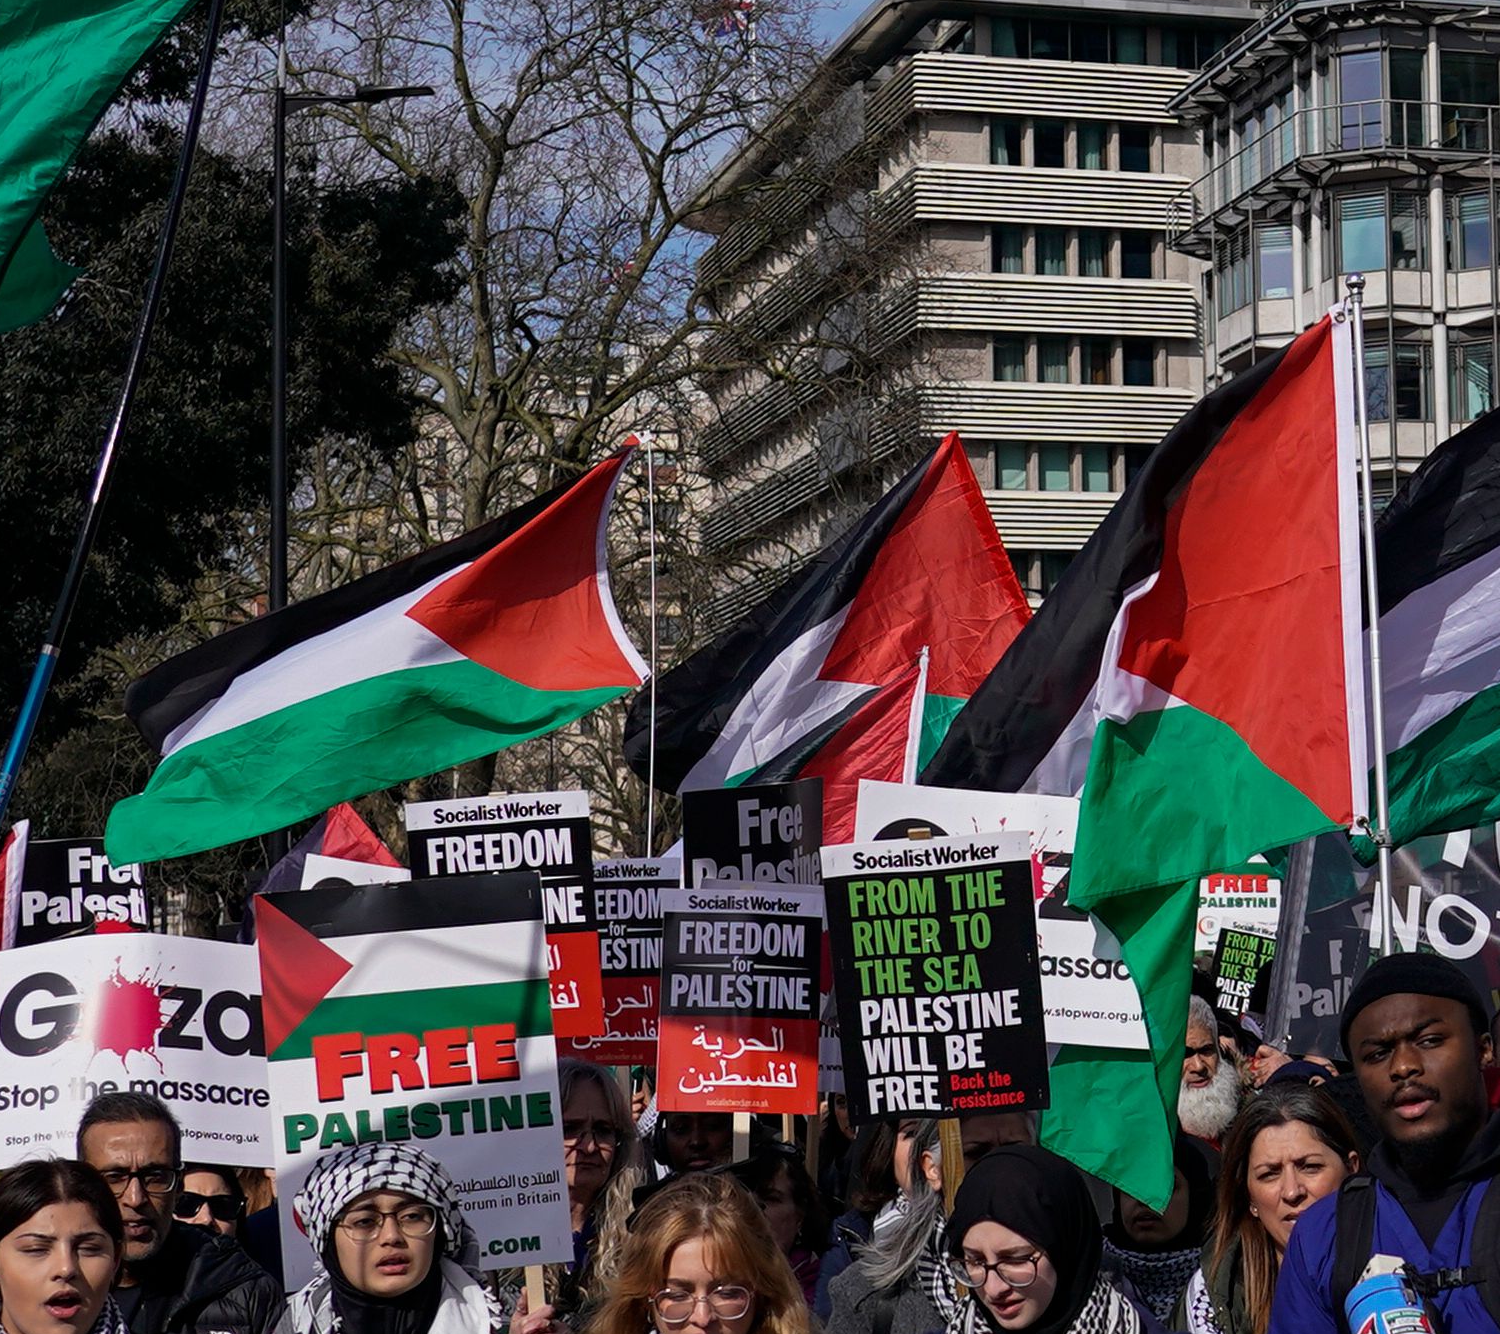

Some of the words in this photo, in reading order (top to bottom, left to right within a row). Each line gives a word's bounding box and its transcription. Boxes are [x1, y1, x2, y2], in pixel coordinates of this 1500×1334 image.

[737, 799, 803, 847] Free
[426, 827, 573, 876] FREEDOM
[848, 876, 937, 917] FROM
[945, 870, 1006, 909] THE
[1207, 872, 1269, 895] FREE
[21, 888, 147, 926] Palesti
[1199, 895, 1277, 909] PALESTINE
[609, 921, 627, 937] for
[678, 921, 805, 958] FREEDOM
[852, 916, 942, 957] RIVER
[950, 912, 992, 950] TO
[1225, 932, 1258, 951] FROM
[732, 955, 754, 973] for
[1220, 962, 1240, 981] THE
[1223, 947, 1255, 967] RIVER
[670, 974, 811, 1011] PALESTINE
[855, 958, 914, 996] THE
[923, 954, 982, 993] SEA
[860, 989, 1022, 1036] PALESTINE
[691, 1025, 785, 1059] الحرية
[862, 1036, 938, 1074] WILL
[946, 1033, 986, 1071] BE
[311, 1022, 521, 1103] FREE
[678, 1061, 798, 1094] لفلسطين
[129, 1078, 270, 1108] massacre
[867, 1075, 942, 1115] FREE
[950, 1074, 984, 1090] Back
[989, 1071, 1011, 1087] the
[952, 1090, 1025, 1109] resistance
[5, 1134, 30, 1147] Stop
[33, 1131, 52, 1142] the
[283, 1091, 554, 1154] PALESTINE
[501, 1196, 513, 1209] in
[517, 1191, 561, 1206] Britain
